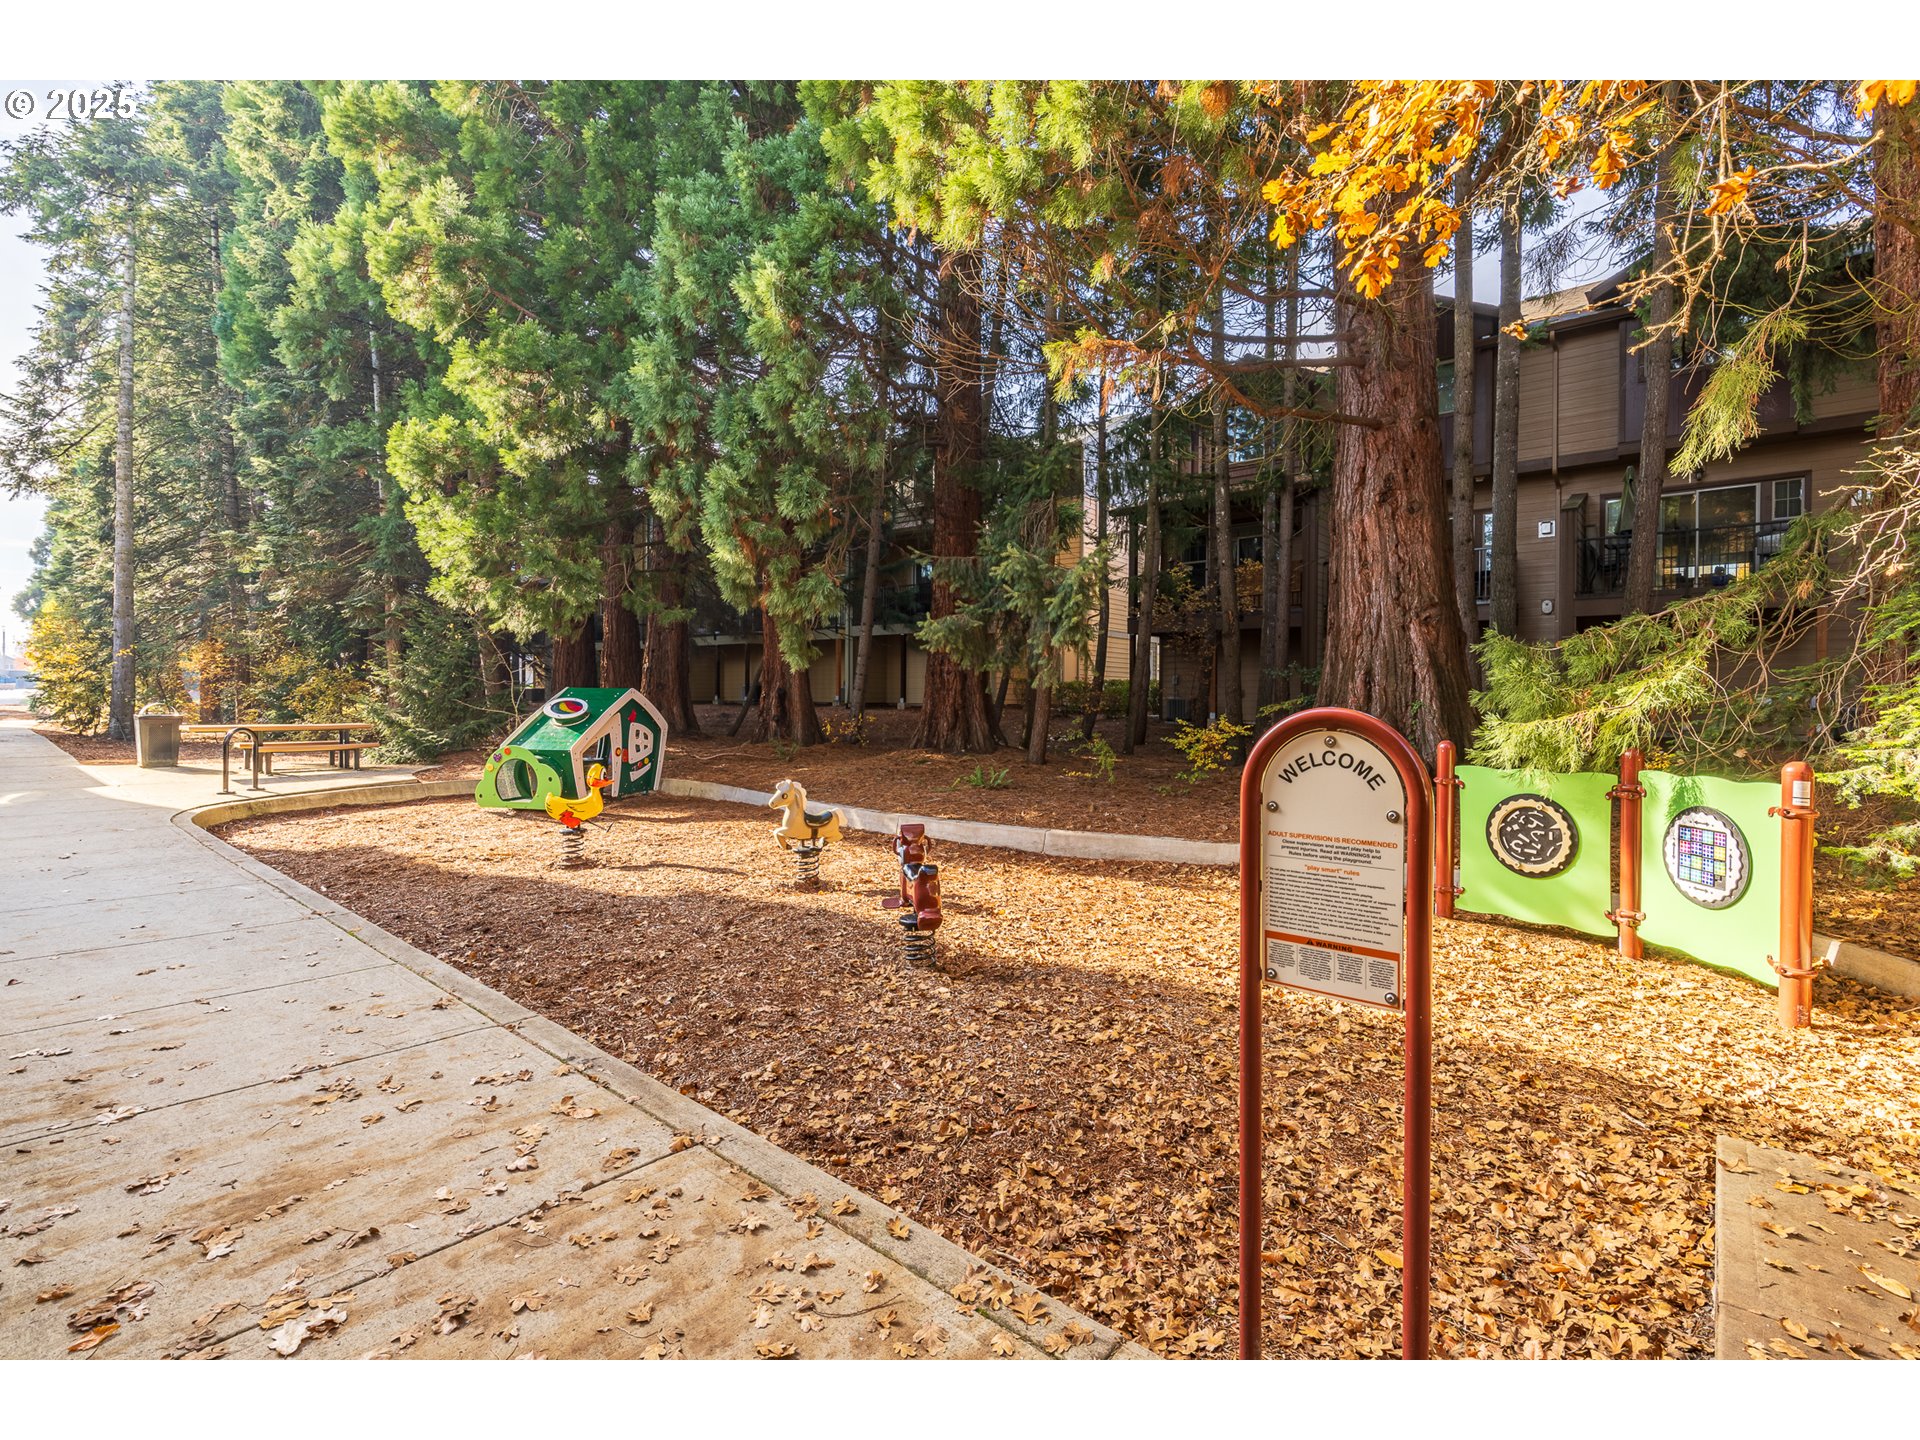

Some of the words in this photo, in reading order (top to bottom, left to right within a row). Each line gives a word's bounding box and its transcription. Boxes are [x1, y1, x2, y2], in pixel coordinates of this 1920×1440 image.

[1278, 750, 1386, 791] WELCOME
[1289, 832, 1332, 842] SUPERVISION
[1342, 837, 1398, 849] RECOMMENDED
[1342, 856, 1372, 864] playground.
[1315, 941, 1353, 953] WARNING
